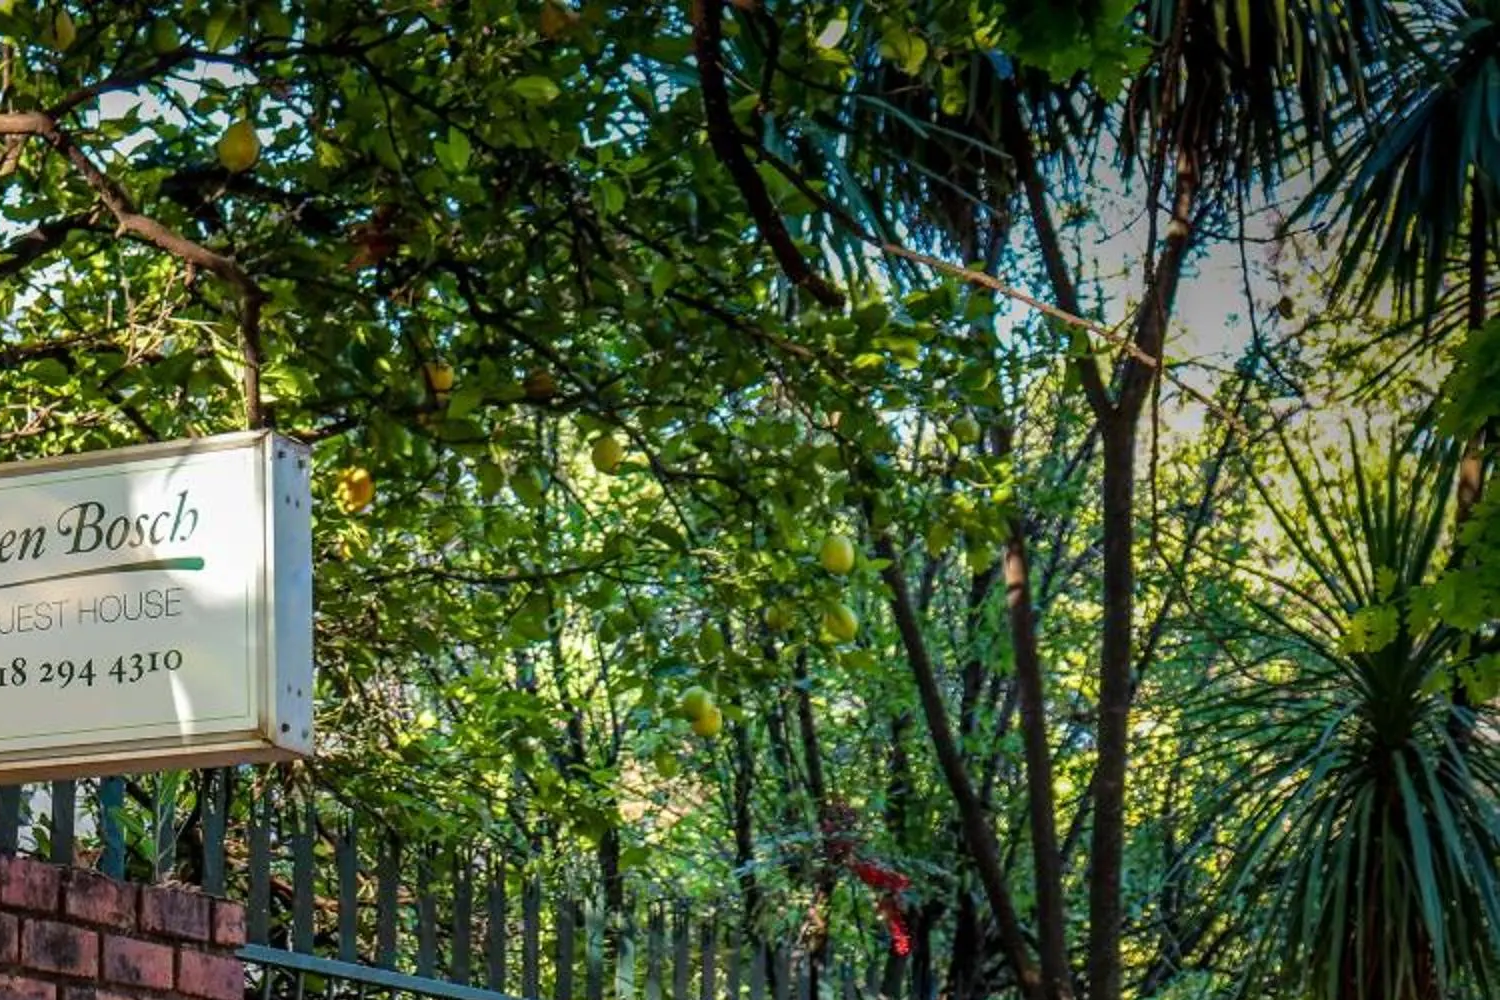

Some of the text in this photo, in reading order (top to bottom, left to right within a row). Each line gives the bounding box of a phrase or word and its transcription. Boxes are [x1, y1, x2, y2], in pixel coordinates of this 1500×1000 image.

[57, 490, 199, 556] Bosch
[79, 587, 184, 626] HOUSE
[39, 658, 97, 691] 294
[108, 648, 184, 685] 4310
